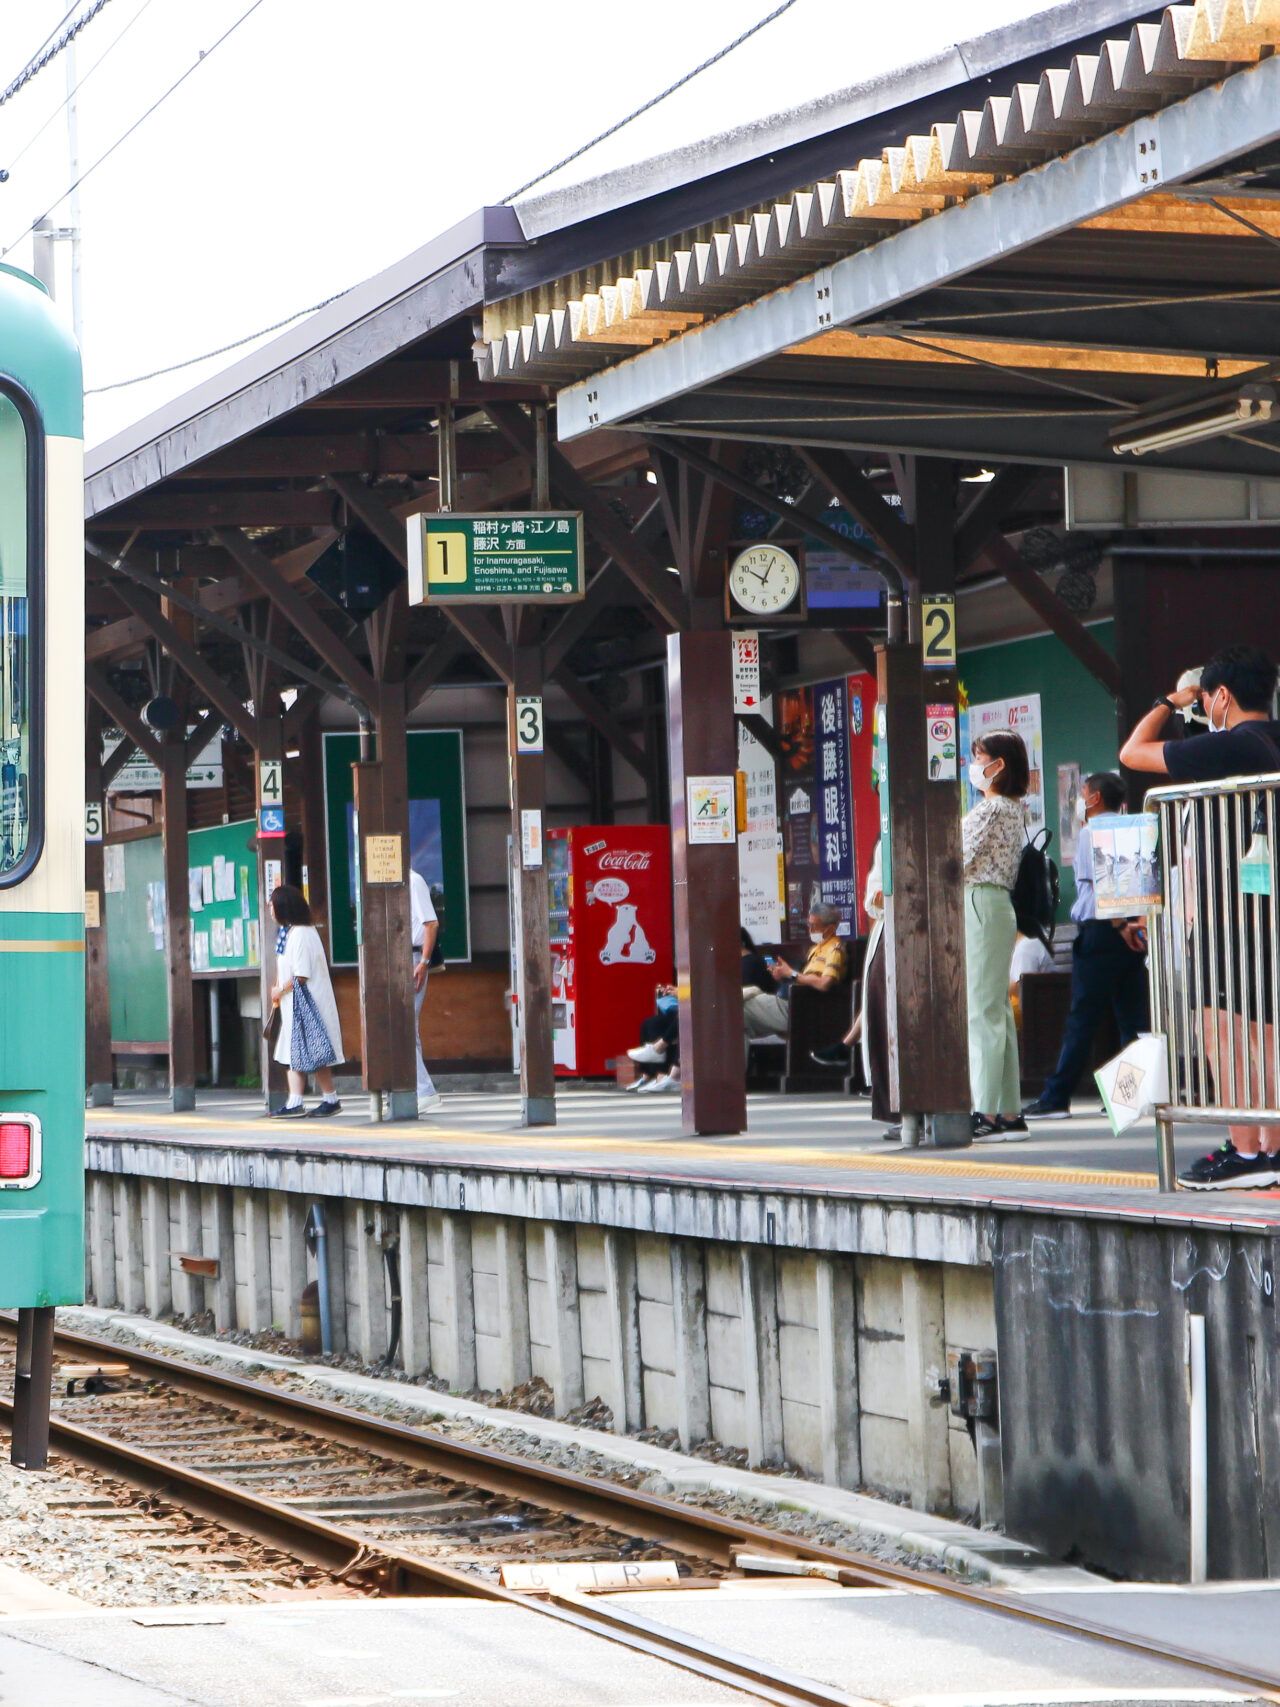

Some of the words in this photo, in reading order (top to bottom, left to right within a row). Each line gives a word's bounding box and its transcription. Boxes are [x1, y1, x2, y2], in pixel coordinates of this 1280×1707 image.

[437, 541, 448, 575] 1
[473, 537, 500, 550] 藤沢
[506, 539, 526, 550] 方面
[473, 557, 485, 565] for
[486, 556, 546, 566] Inamuragasaki,
[474, 566, 515, 575] Enoshima,
[517, 566, 532, 574] and
[533, 566, 568, 575] Fujisawa
[925, 608, 952, 657] 2
[520, 707, 540, 744] 3
[262, 769, 280, 799] 4
[821, 694, 841, 873] 後藤眼科
[86, 810, 99, 835] 5
